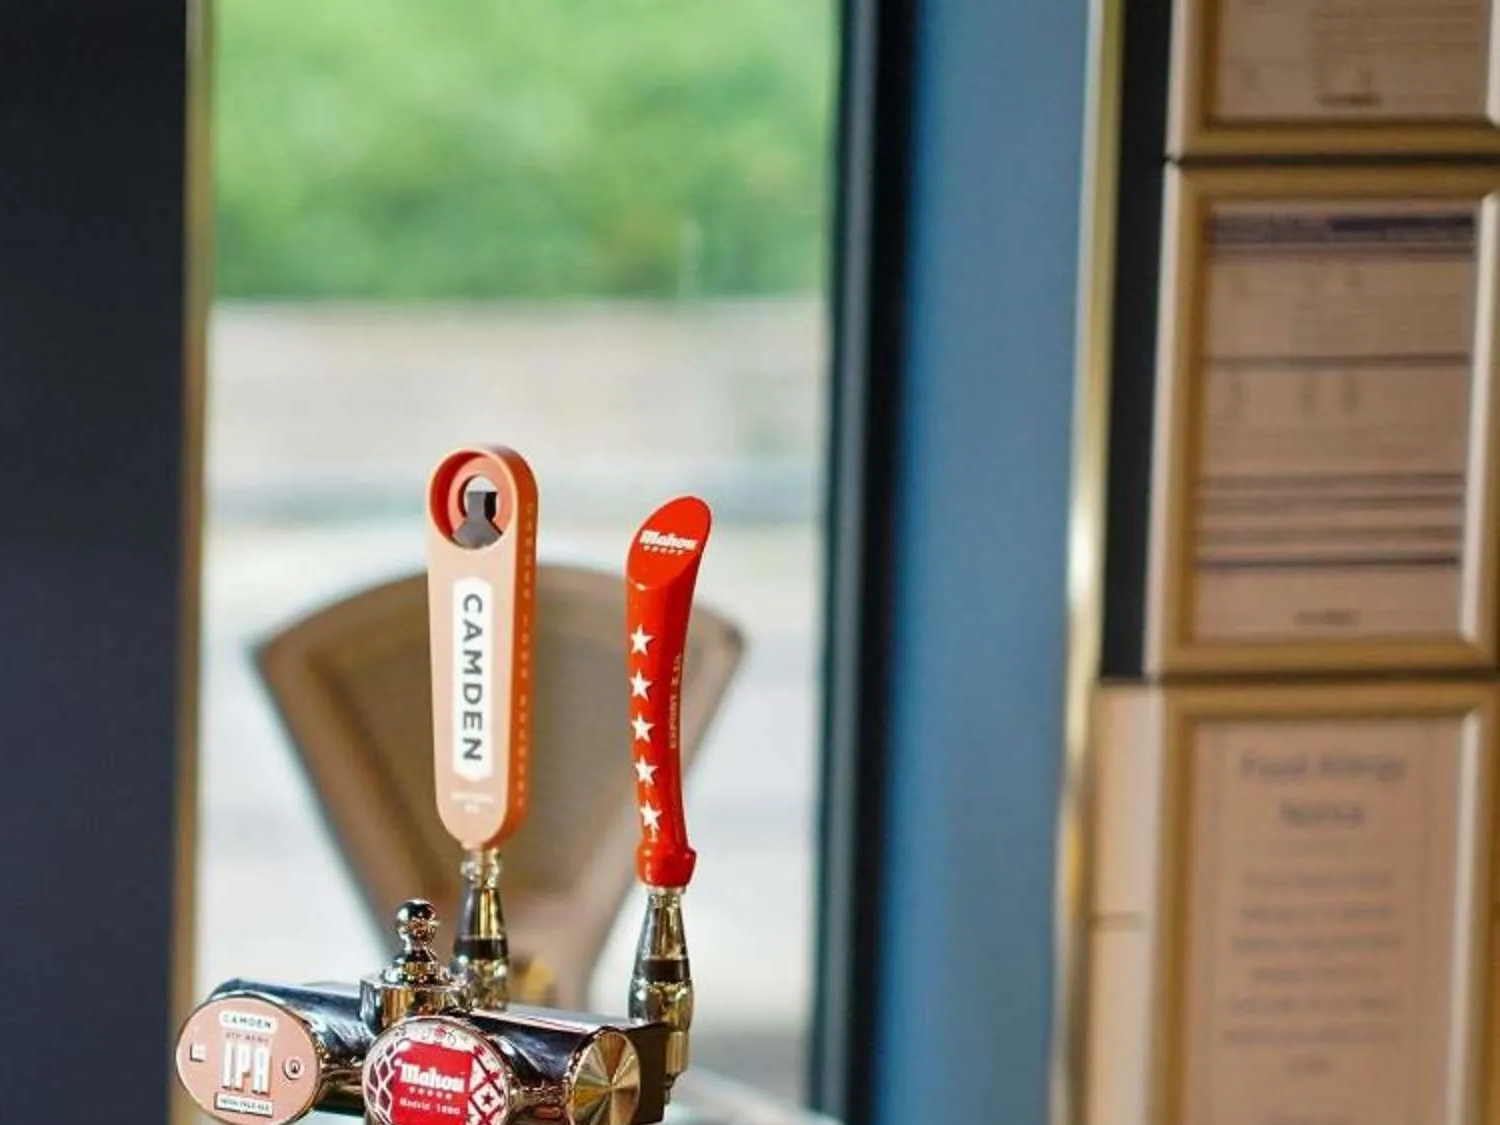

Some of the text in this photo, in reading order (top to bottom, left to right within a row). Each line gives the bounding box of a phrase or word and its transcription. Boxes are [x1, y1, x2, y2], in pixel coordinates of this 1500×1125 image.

[462, 592, 484, 762] CAMDEN
[222, 1012, 272, 1029] CAMDEN
[222, 1039, 271, 1095] IPA
[394, 1057, 466, 1093] Mahou
